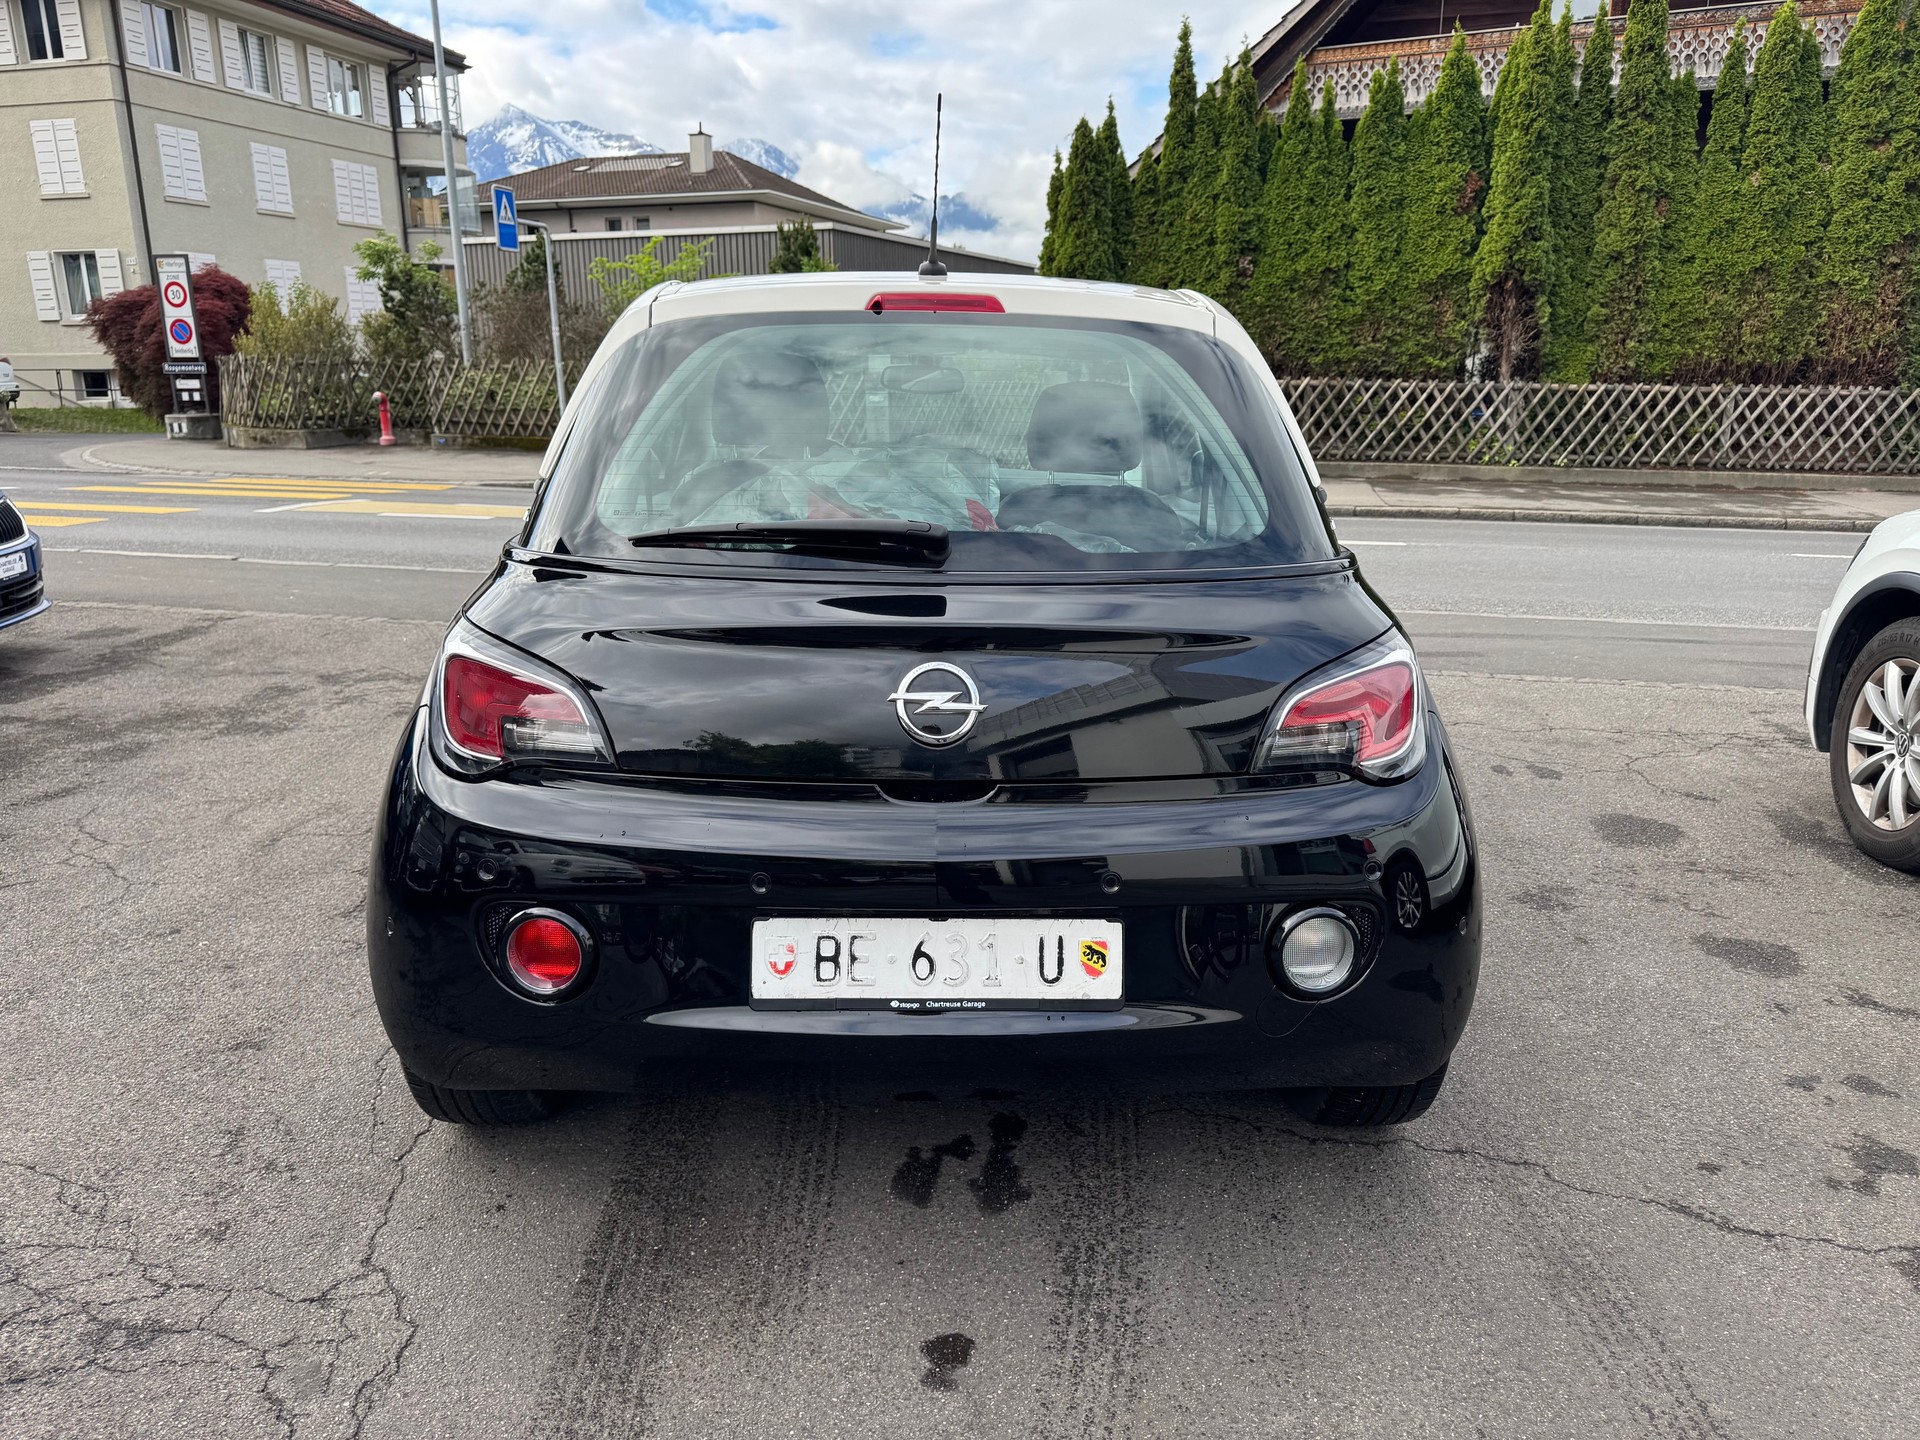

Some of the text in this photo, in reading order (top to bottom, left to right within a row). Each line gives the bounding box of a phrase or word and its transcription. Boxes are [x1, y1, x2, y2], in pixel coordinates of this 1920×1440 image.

[170, 289, 181, 300] 30
[1877, 633, 1898, 647] 215/65
[1899, 632, 1905, 640] R
[813, 930, 1066, 988] BE 631 U
[962, 1000, 986, 1008] Garage
